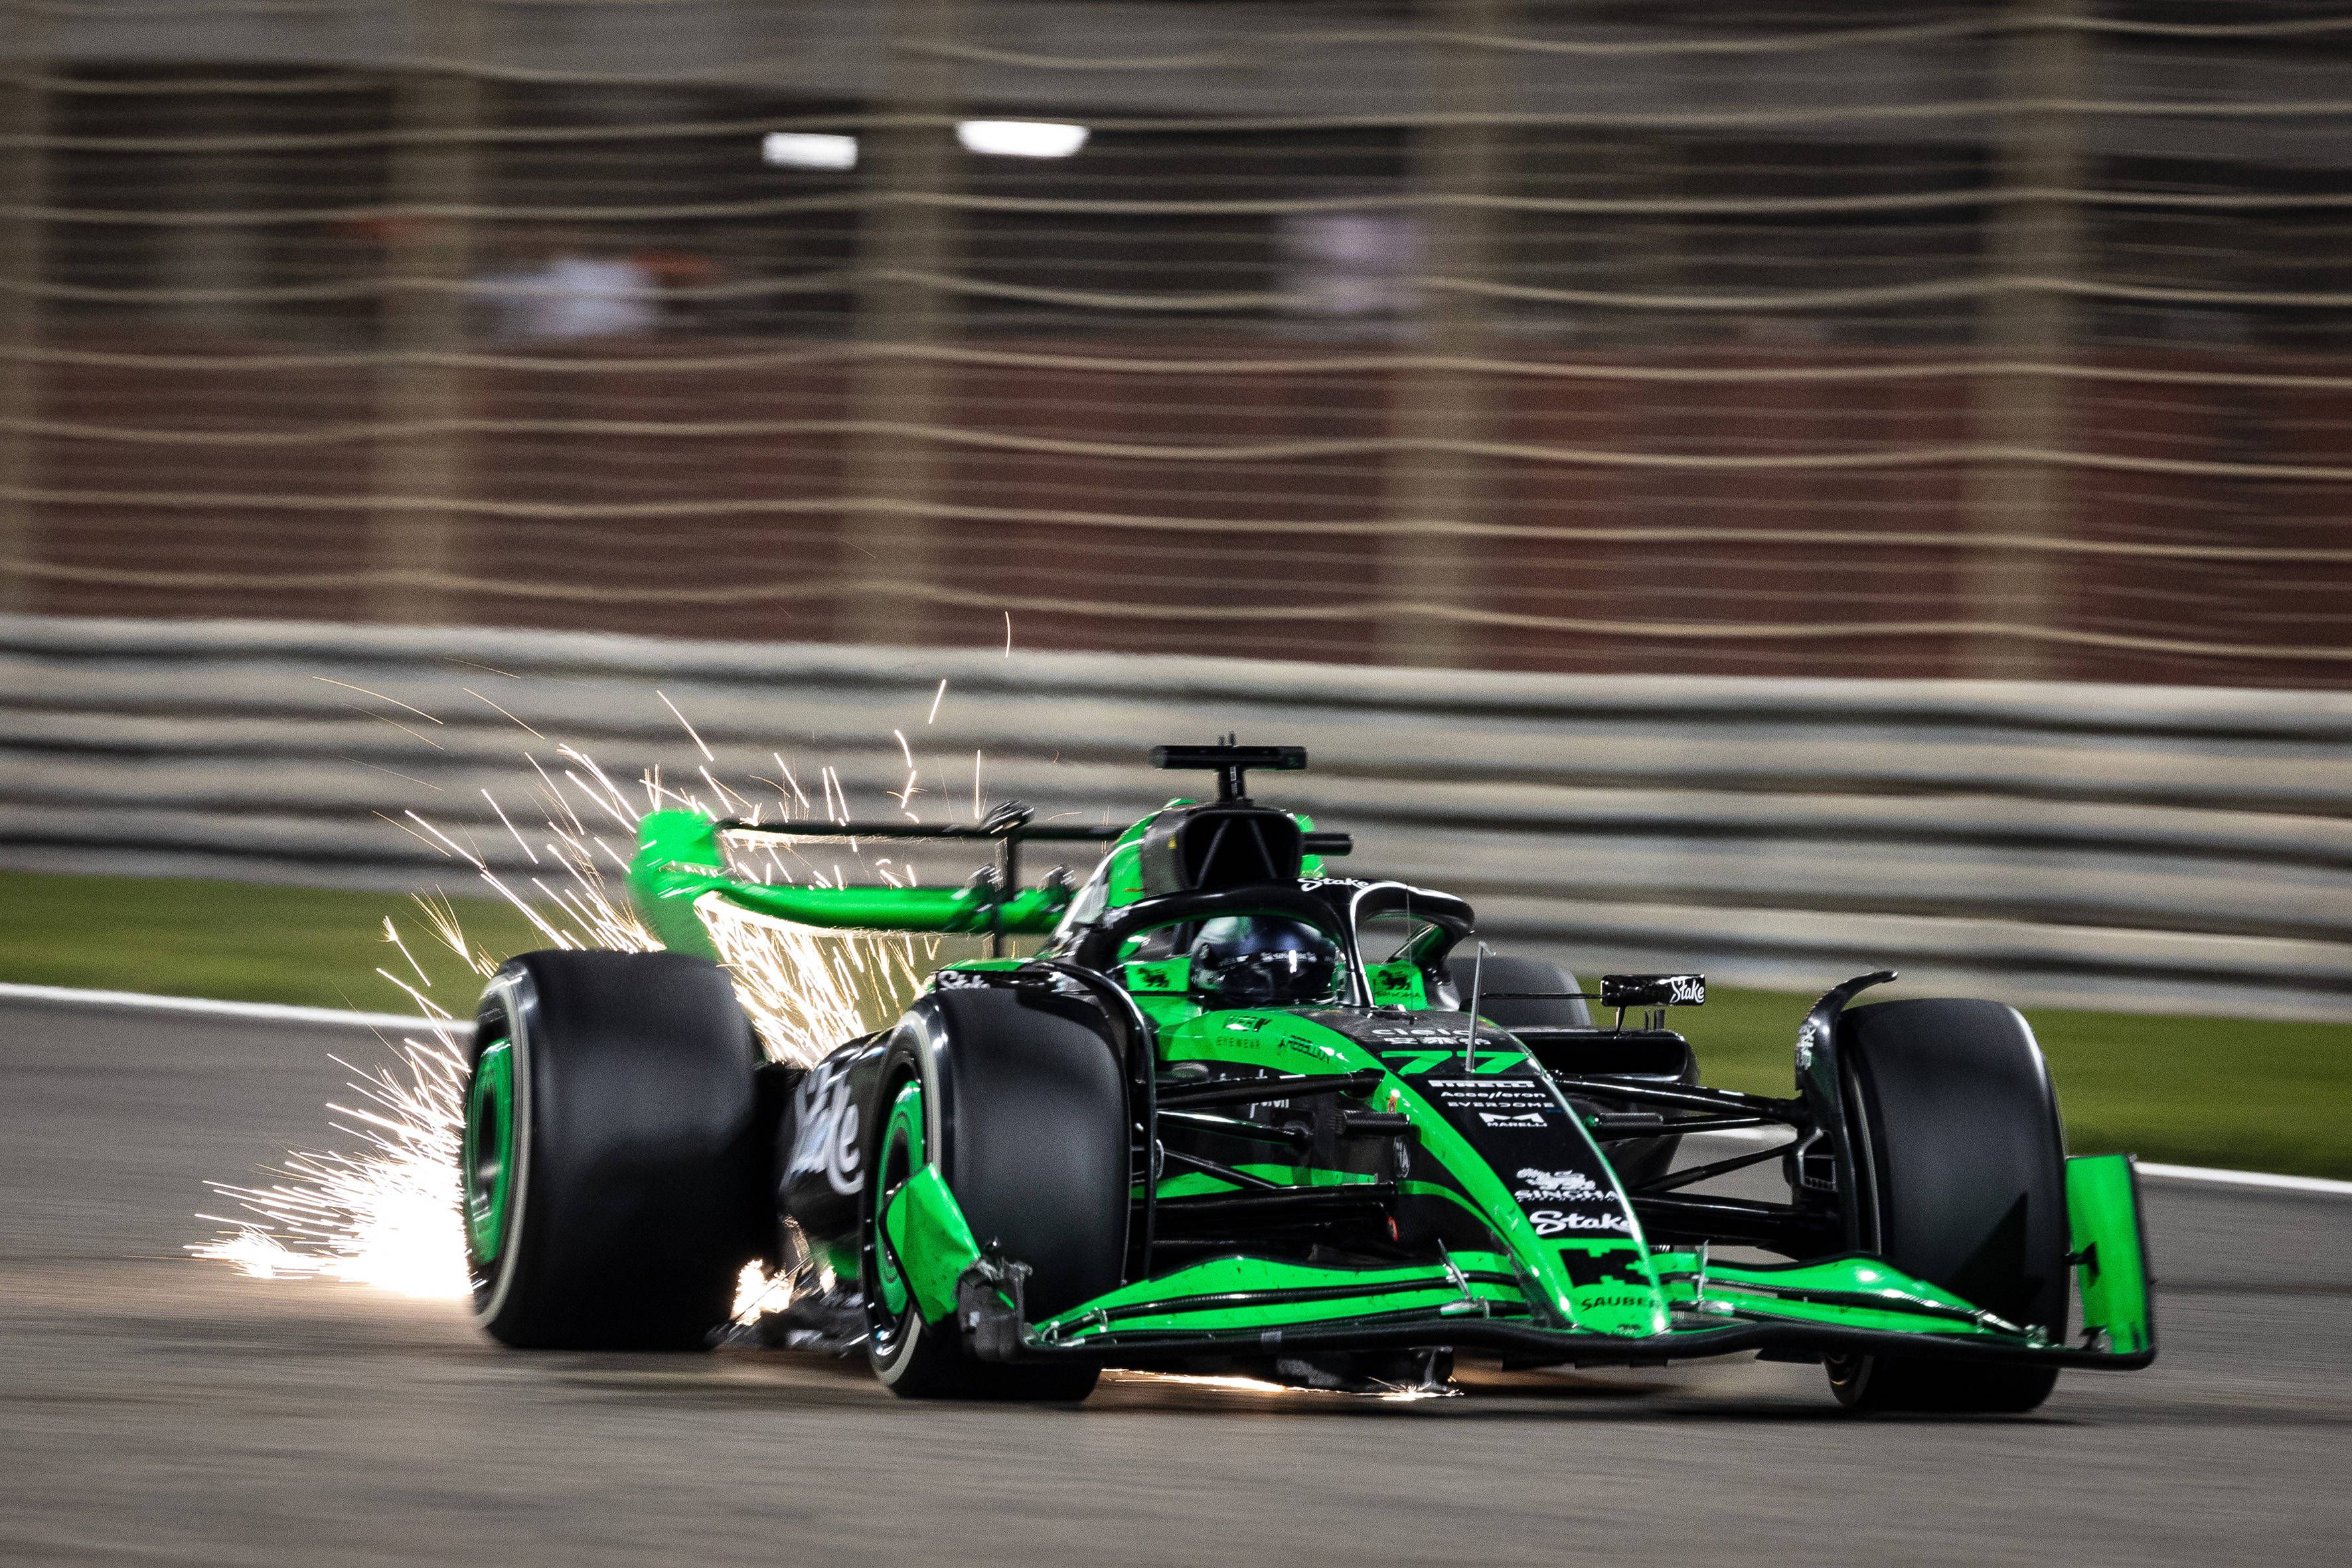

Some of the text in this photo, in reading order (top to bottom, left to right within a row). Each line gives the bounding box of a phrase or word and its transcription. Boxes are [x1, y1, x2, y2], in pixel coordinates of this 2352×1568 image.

[1298, 878, 1370, 892] Stake
[1670, 977, 1705, 1003] Stake
[1381, 1050, 1528, 1075] 77
